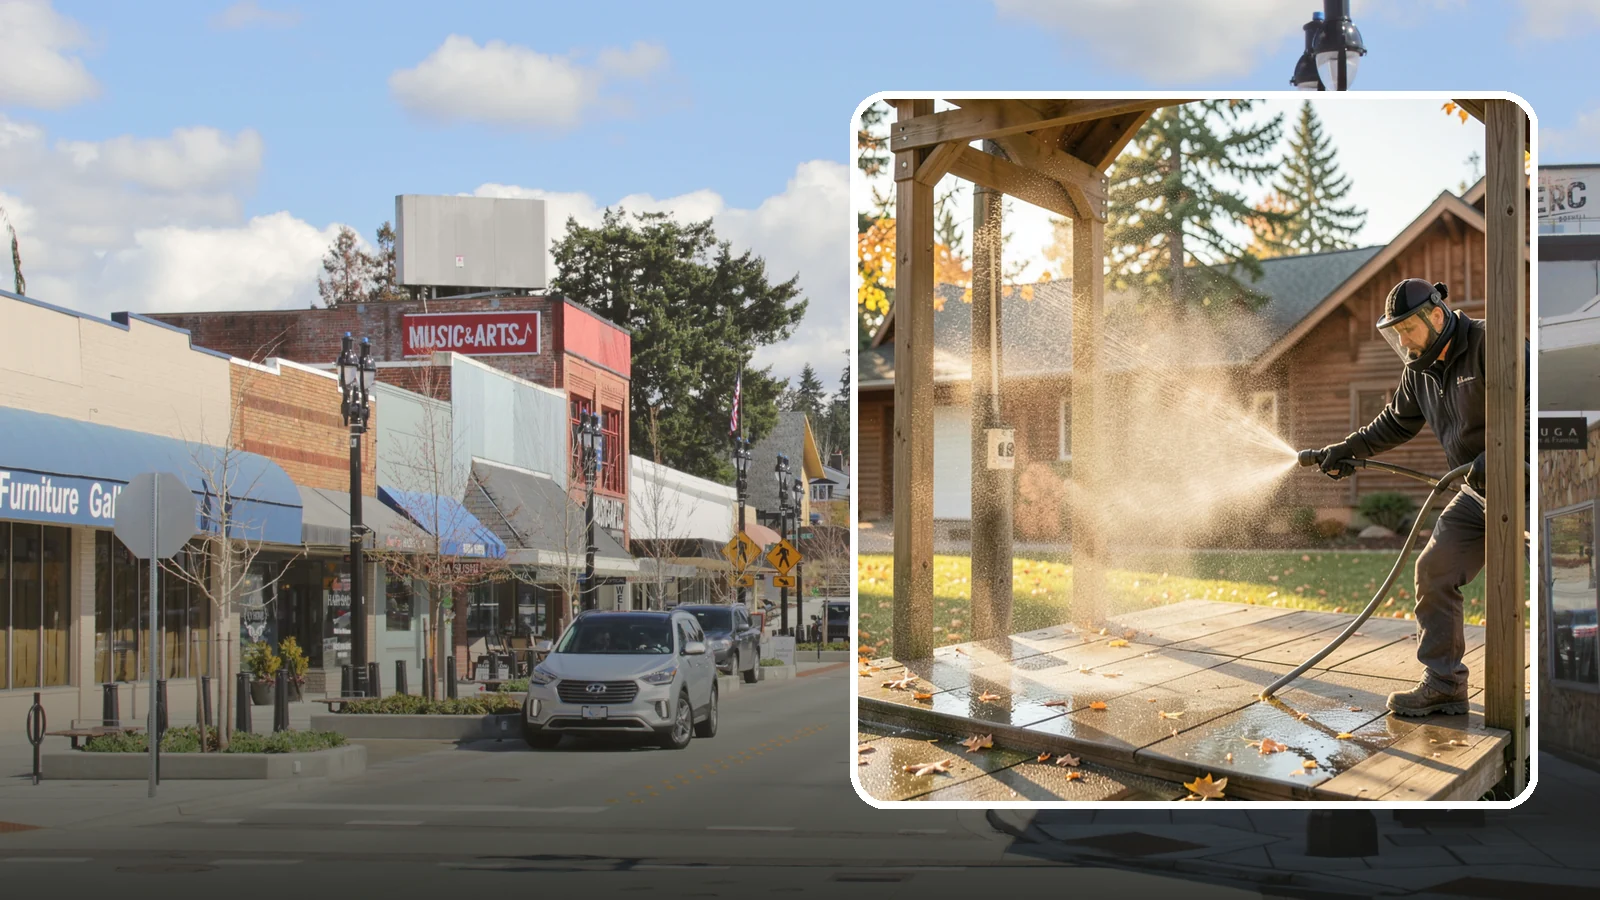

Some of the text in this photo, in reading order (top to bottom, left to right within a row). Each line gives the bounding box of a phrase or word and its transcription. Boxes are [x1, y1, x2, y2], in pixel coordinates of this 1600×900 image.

[408, 322, 520, 349] MUSIC&ARTS
[0, 471, 122, 519] Furniture Gal
